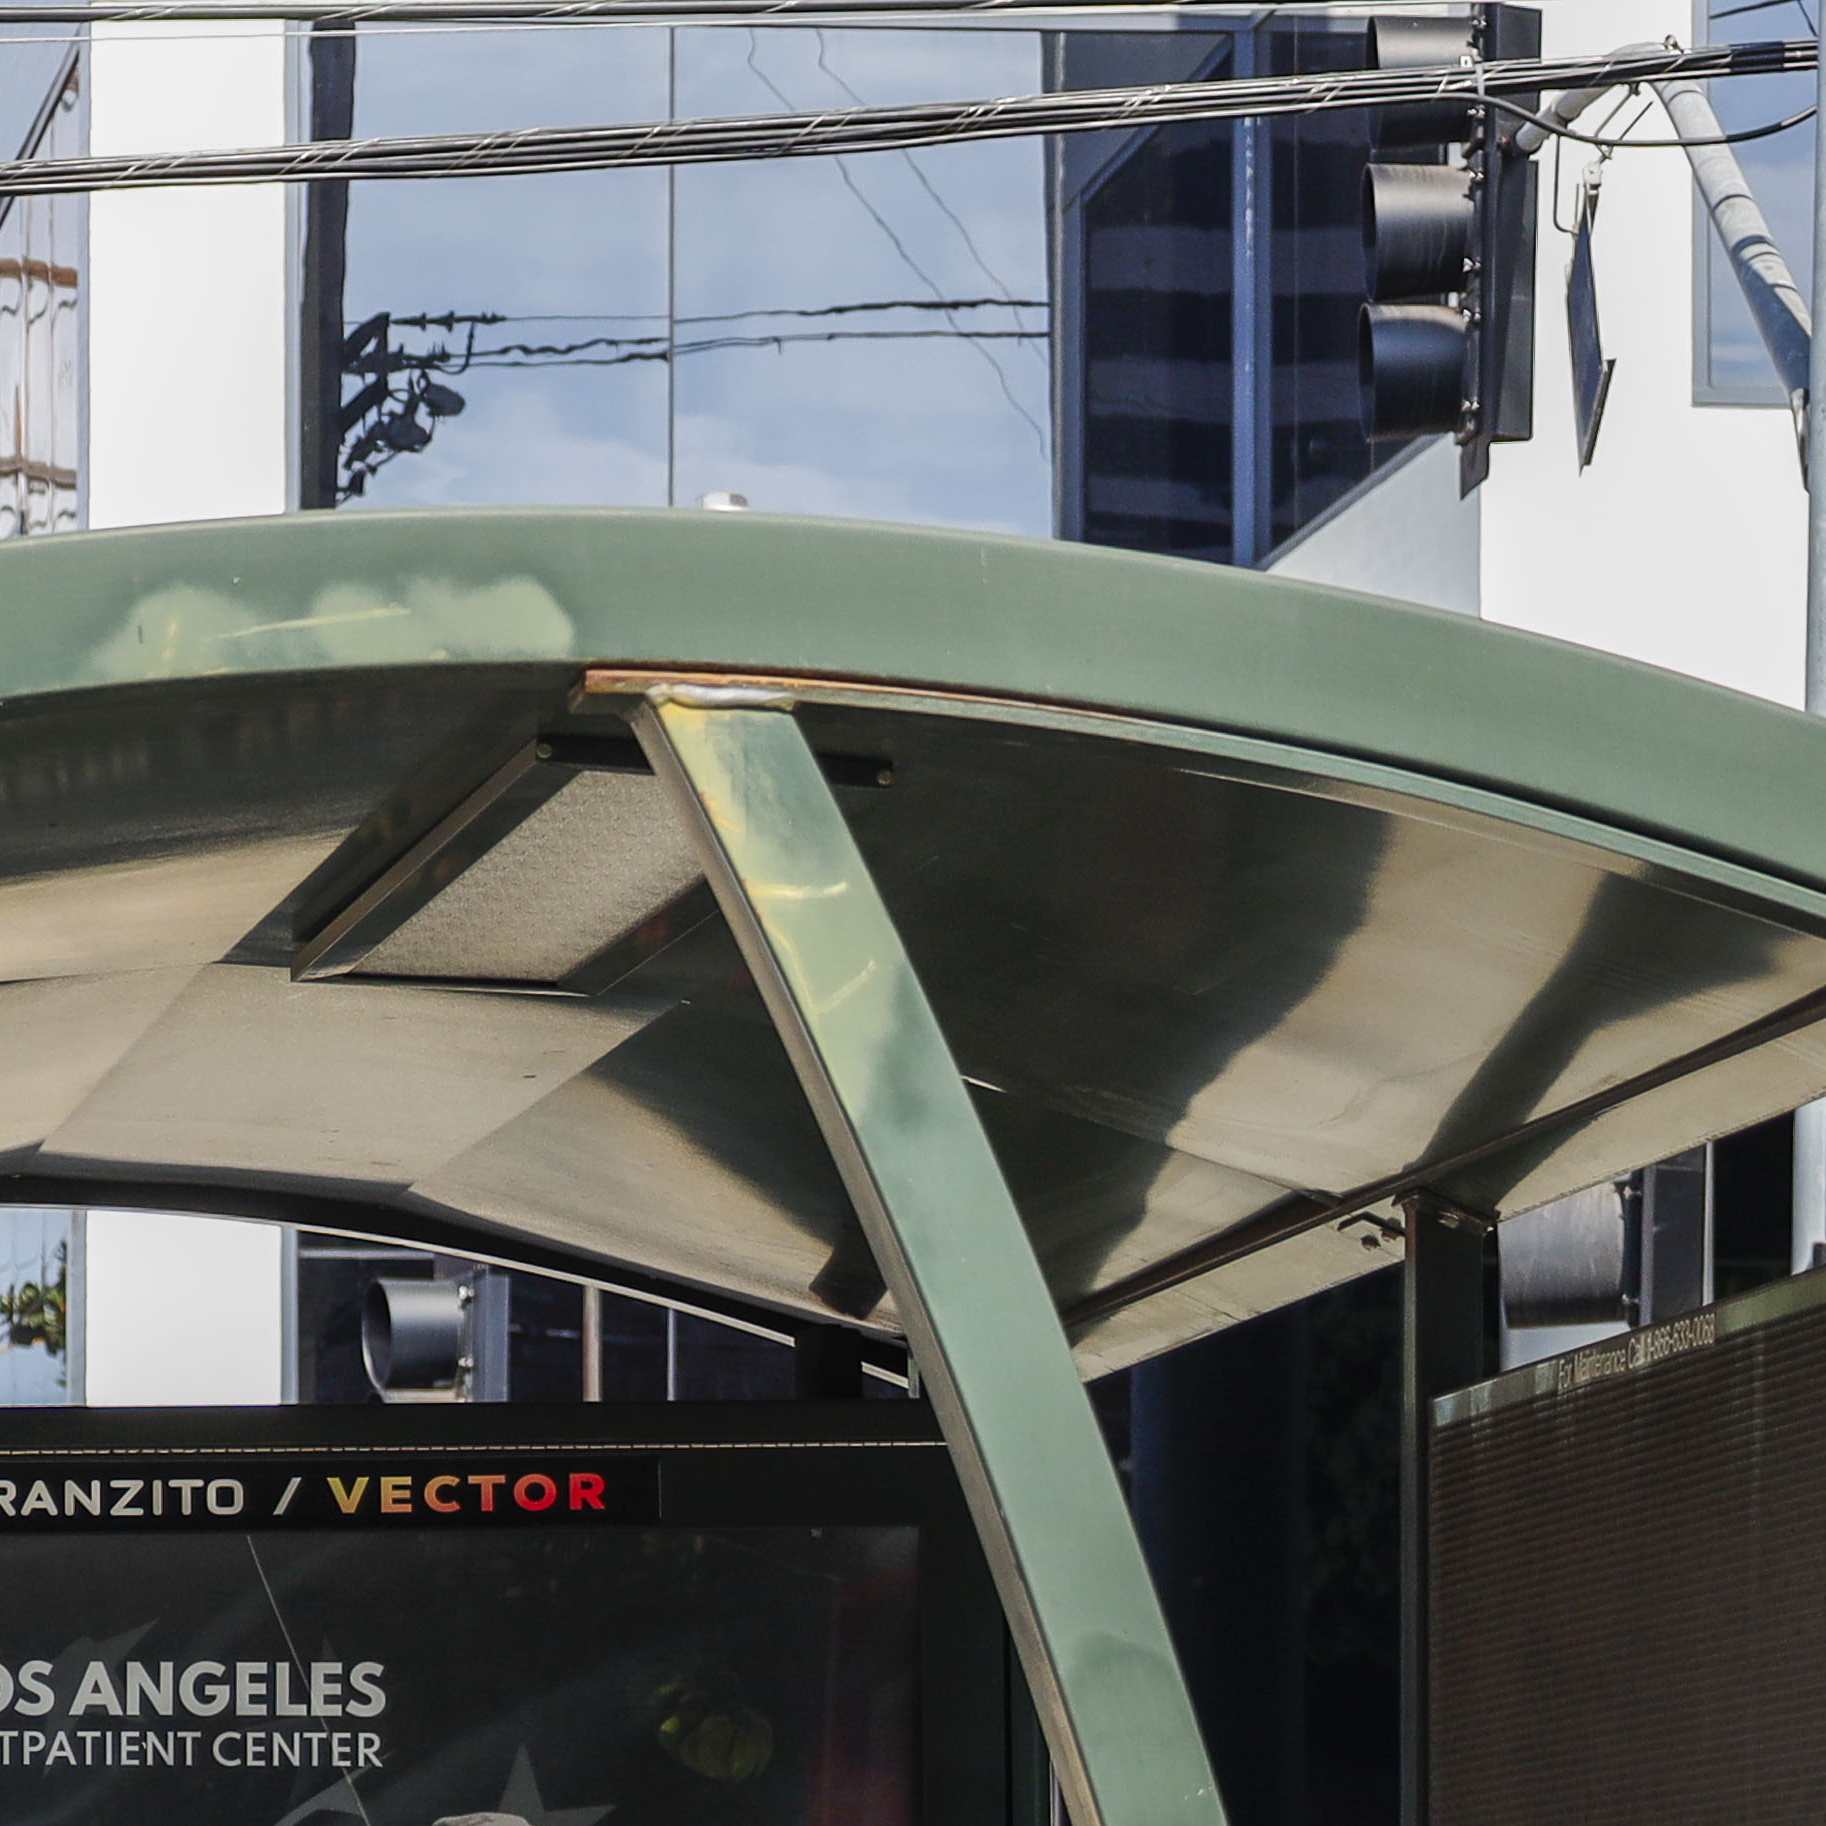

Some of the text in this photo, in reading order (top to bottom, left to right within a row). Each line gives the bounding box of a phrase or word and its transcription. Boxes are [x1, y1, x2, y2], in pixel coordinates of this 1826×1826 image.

[326, 1472, 606, 1514] VECTOR
[69, 1660, 386, 1717] ANGELES
[212, 1730, 384, 1767] CENTER
